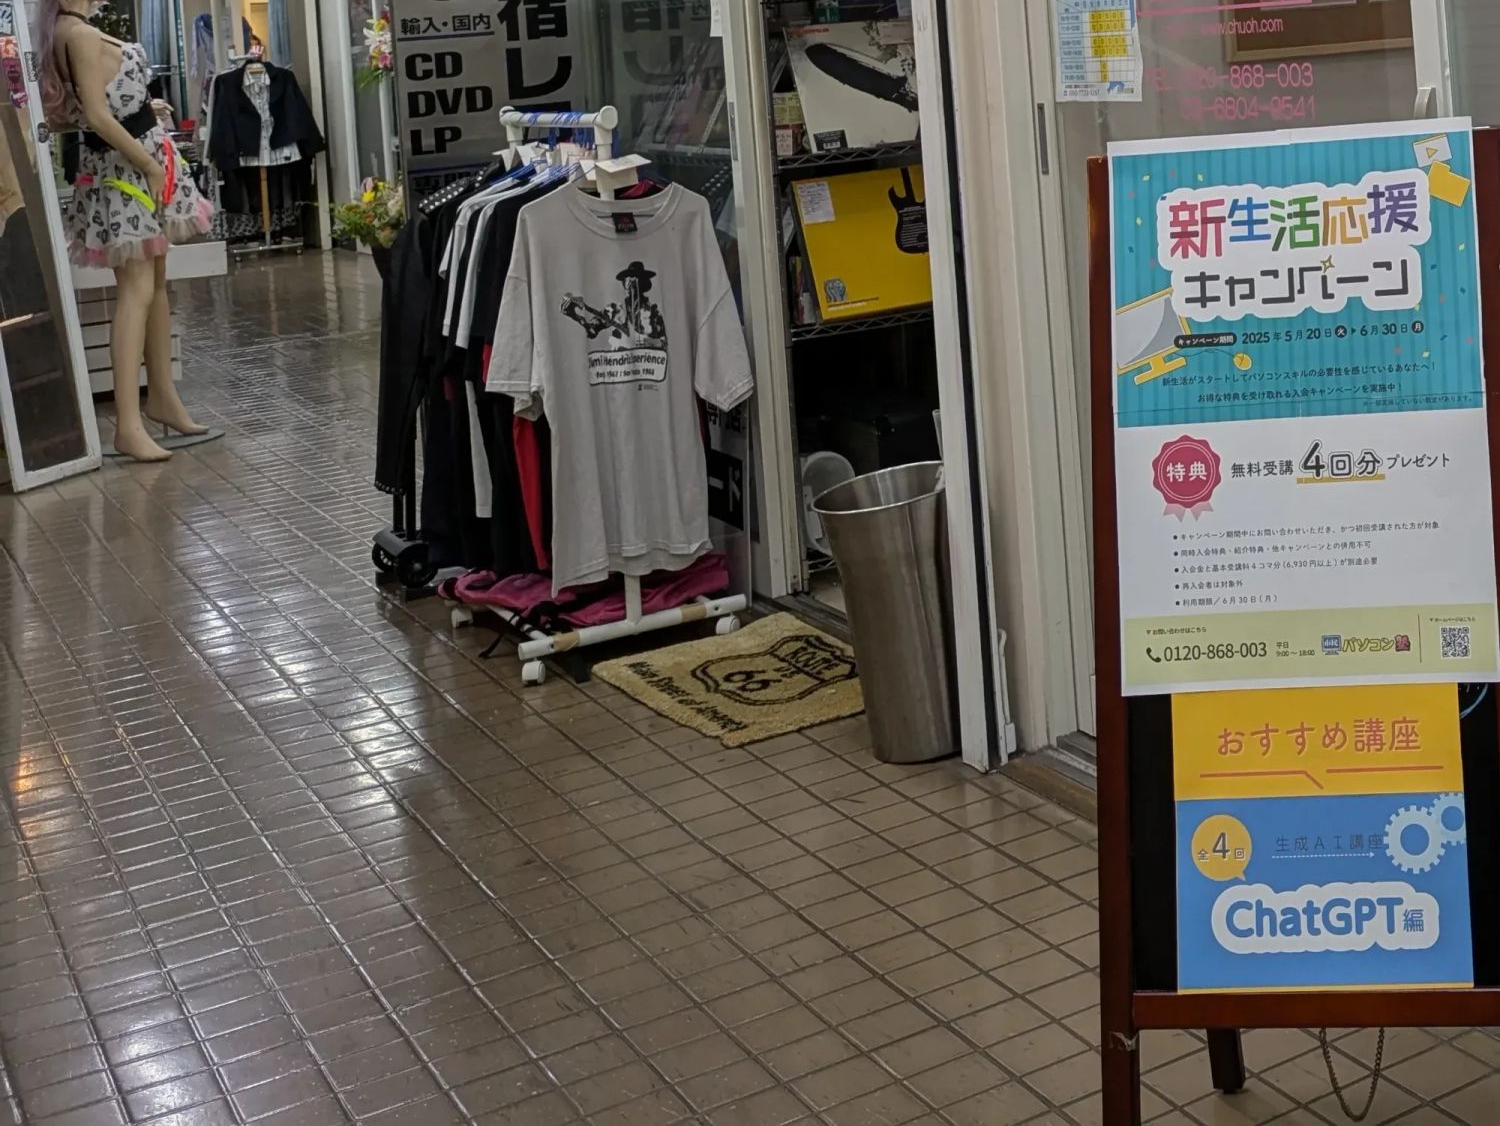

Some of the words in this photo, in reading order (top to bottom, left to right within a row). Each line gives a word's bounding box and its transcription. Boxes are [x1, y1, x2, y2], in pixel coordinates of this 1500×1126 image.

[400, 13, 491, 36] 輸入・国内
[405, 51, 463, 81] CD
[408, 85, 493, 119] DVD
[409, 126, 462, 156] LP
[1168, 181, 1419, 260] 新生活応援
[1183, 258, 1409, 308] キャンペーン
[1166, 461, 1208, 483] 特典
[1230, 459, 1294, 478] 無料受講
[1300, 439, 1382, 480] 4回分
[1387, 453, 1451, 470] プレゼント
[786, 647, 840, 676] ROUTE
[1164, 641, 1268, 662] 0120-868-003
[723, 670, 782, 692] 66
[1217, 717, 1422, 756] おすすめ講座
[1197, 831, 1246, 862] 全4回
